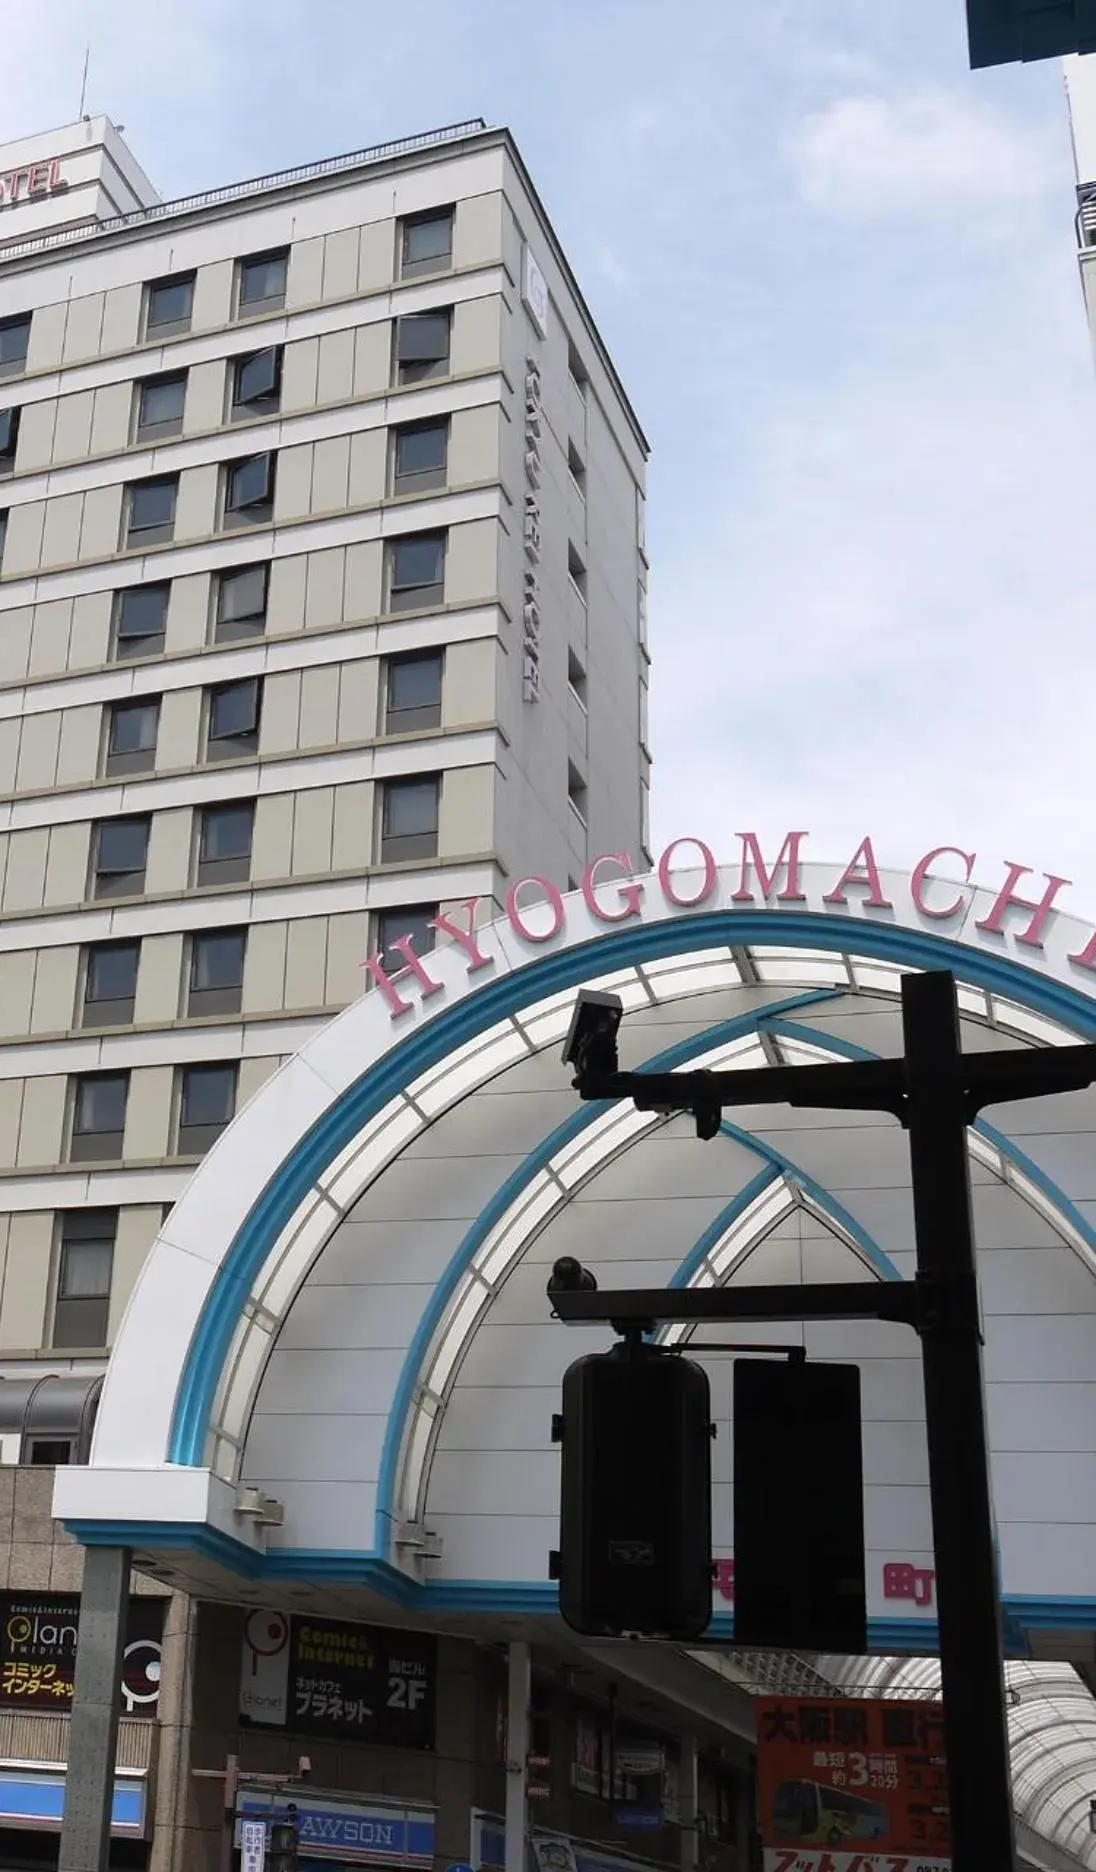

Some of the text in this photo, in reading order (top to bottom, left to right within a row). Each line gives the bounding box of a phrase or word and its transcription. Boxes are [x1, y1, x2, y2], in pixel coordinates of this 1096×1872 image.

[7, 1615, 78, 1653] Plan
[2, 1678, 75, 1697] インターネッ
[3, 1662, 57, 1678] コミック
[296, 1690, 373, 1725] プラネット
[386, 1676, 429, 1711] 2F
[848, 1751, 869, 1786] 3
[300, 1816, 392, 1845] AWSON
